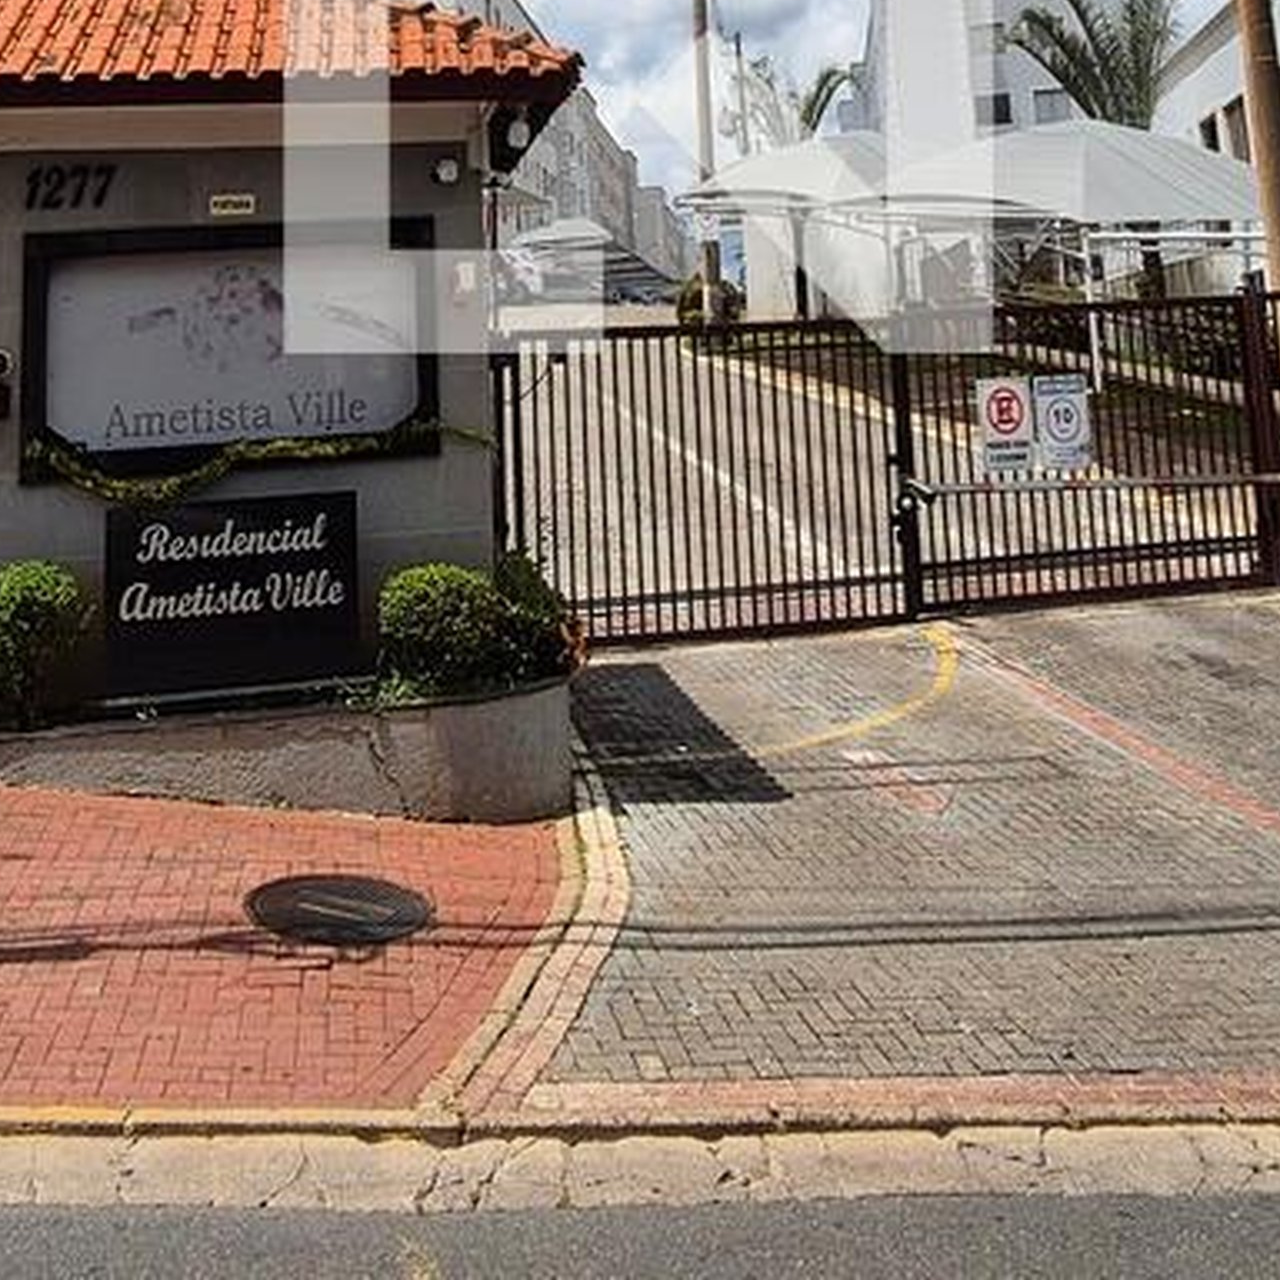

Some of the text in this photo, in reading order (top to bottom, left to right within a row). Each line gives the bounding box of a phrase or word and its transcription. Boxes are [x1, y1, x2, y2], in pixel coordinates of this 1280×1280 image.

[25, 163, 118, 211] 1277
[105, 388, 368, 439] Ametista Ville
[1052, 406, 1074, 425] 10
[136, 512, 327, 564] Residencial
[119, 568, 346, 622] Ametista Ville
